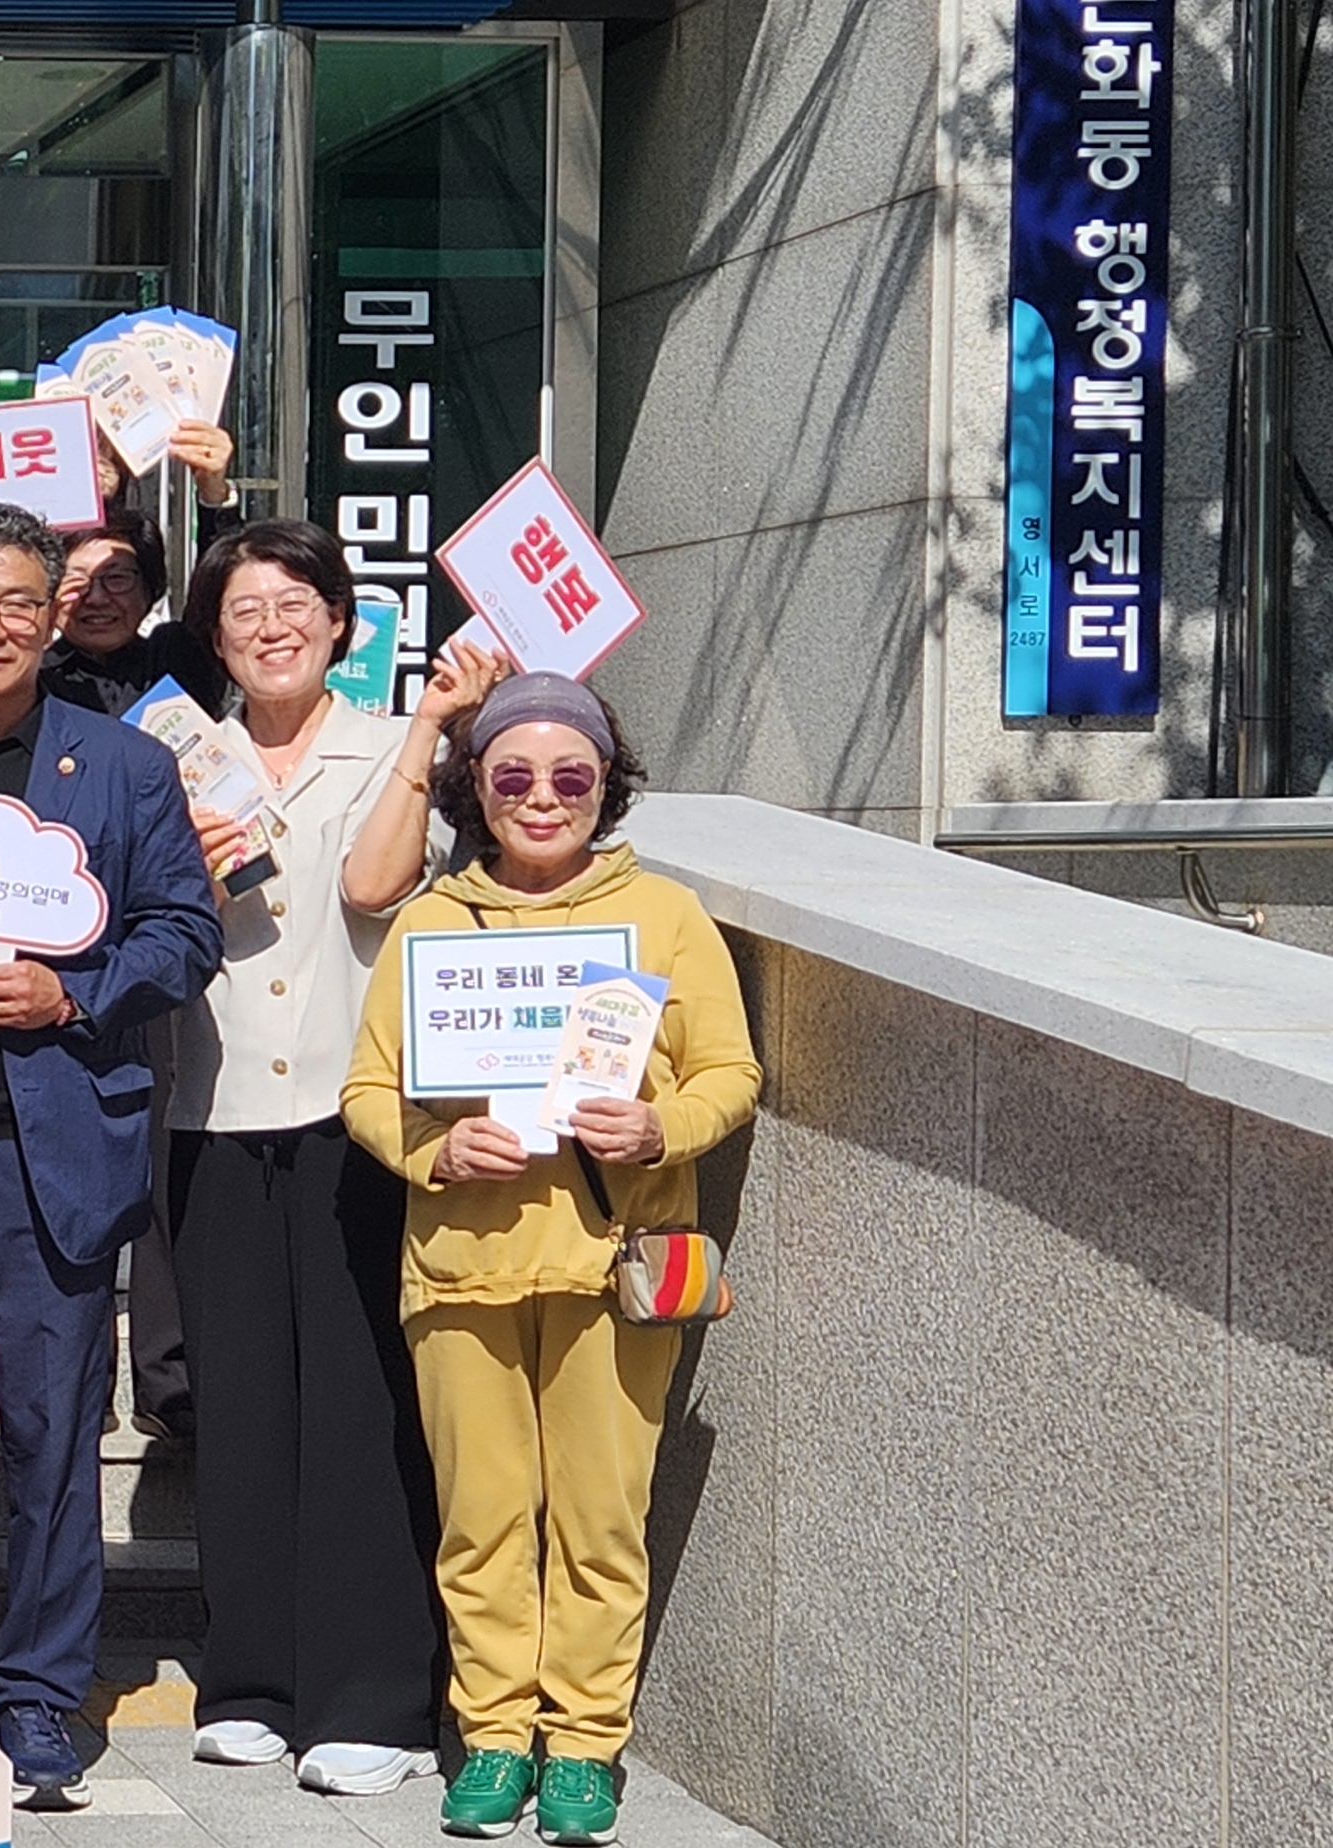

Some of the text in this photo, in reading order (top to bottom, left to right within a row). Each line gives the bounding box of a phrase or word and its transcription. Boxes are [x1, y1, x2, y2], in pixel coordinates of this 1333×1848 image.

[337, 290, 435, 462] 무인
[1067, 219, 1148, 672] 행정복지센터
[509, 513, 602, 636] 행복
[1019, 516, 1041, 617] 영서로
[1009, 631, 1046, 647] 2487
[428, 1007, 503, 1032] 우리가
[435, 963, 582, 991] 우리 동네 온
